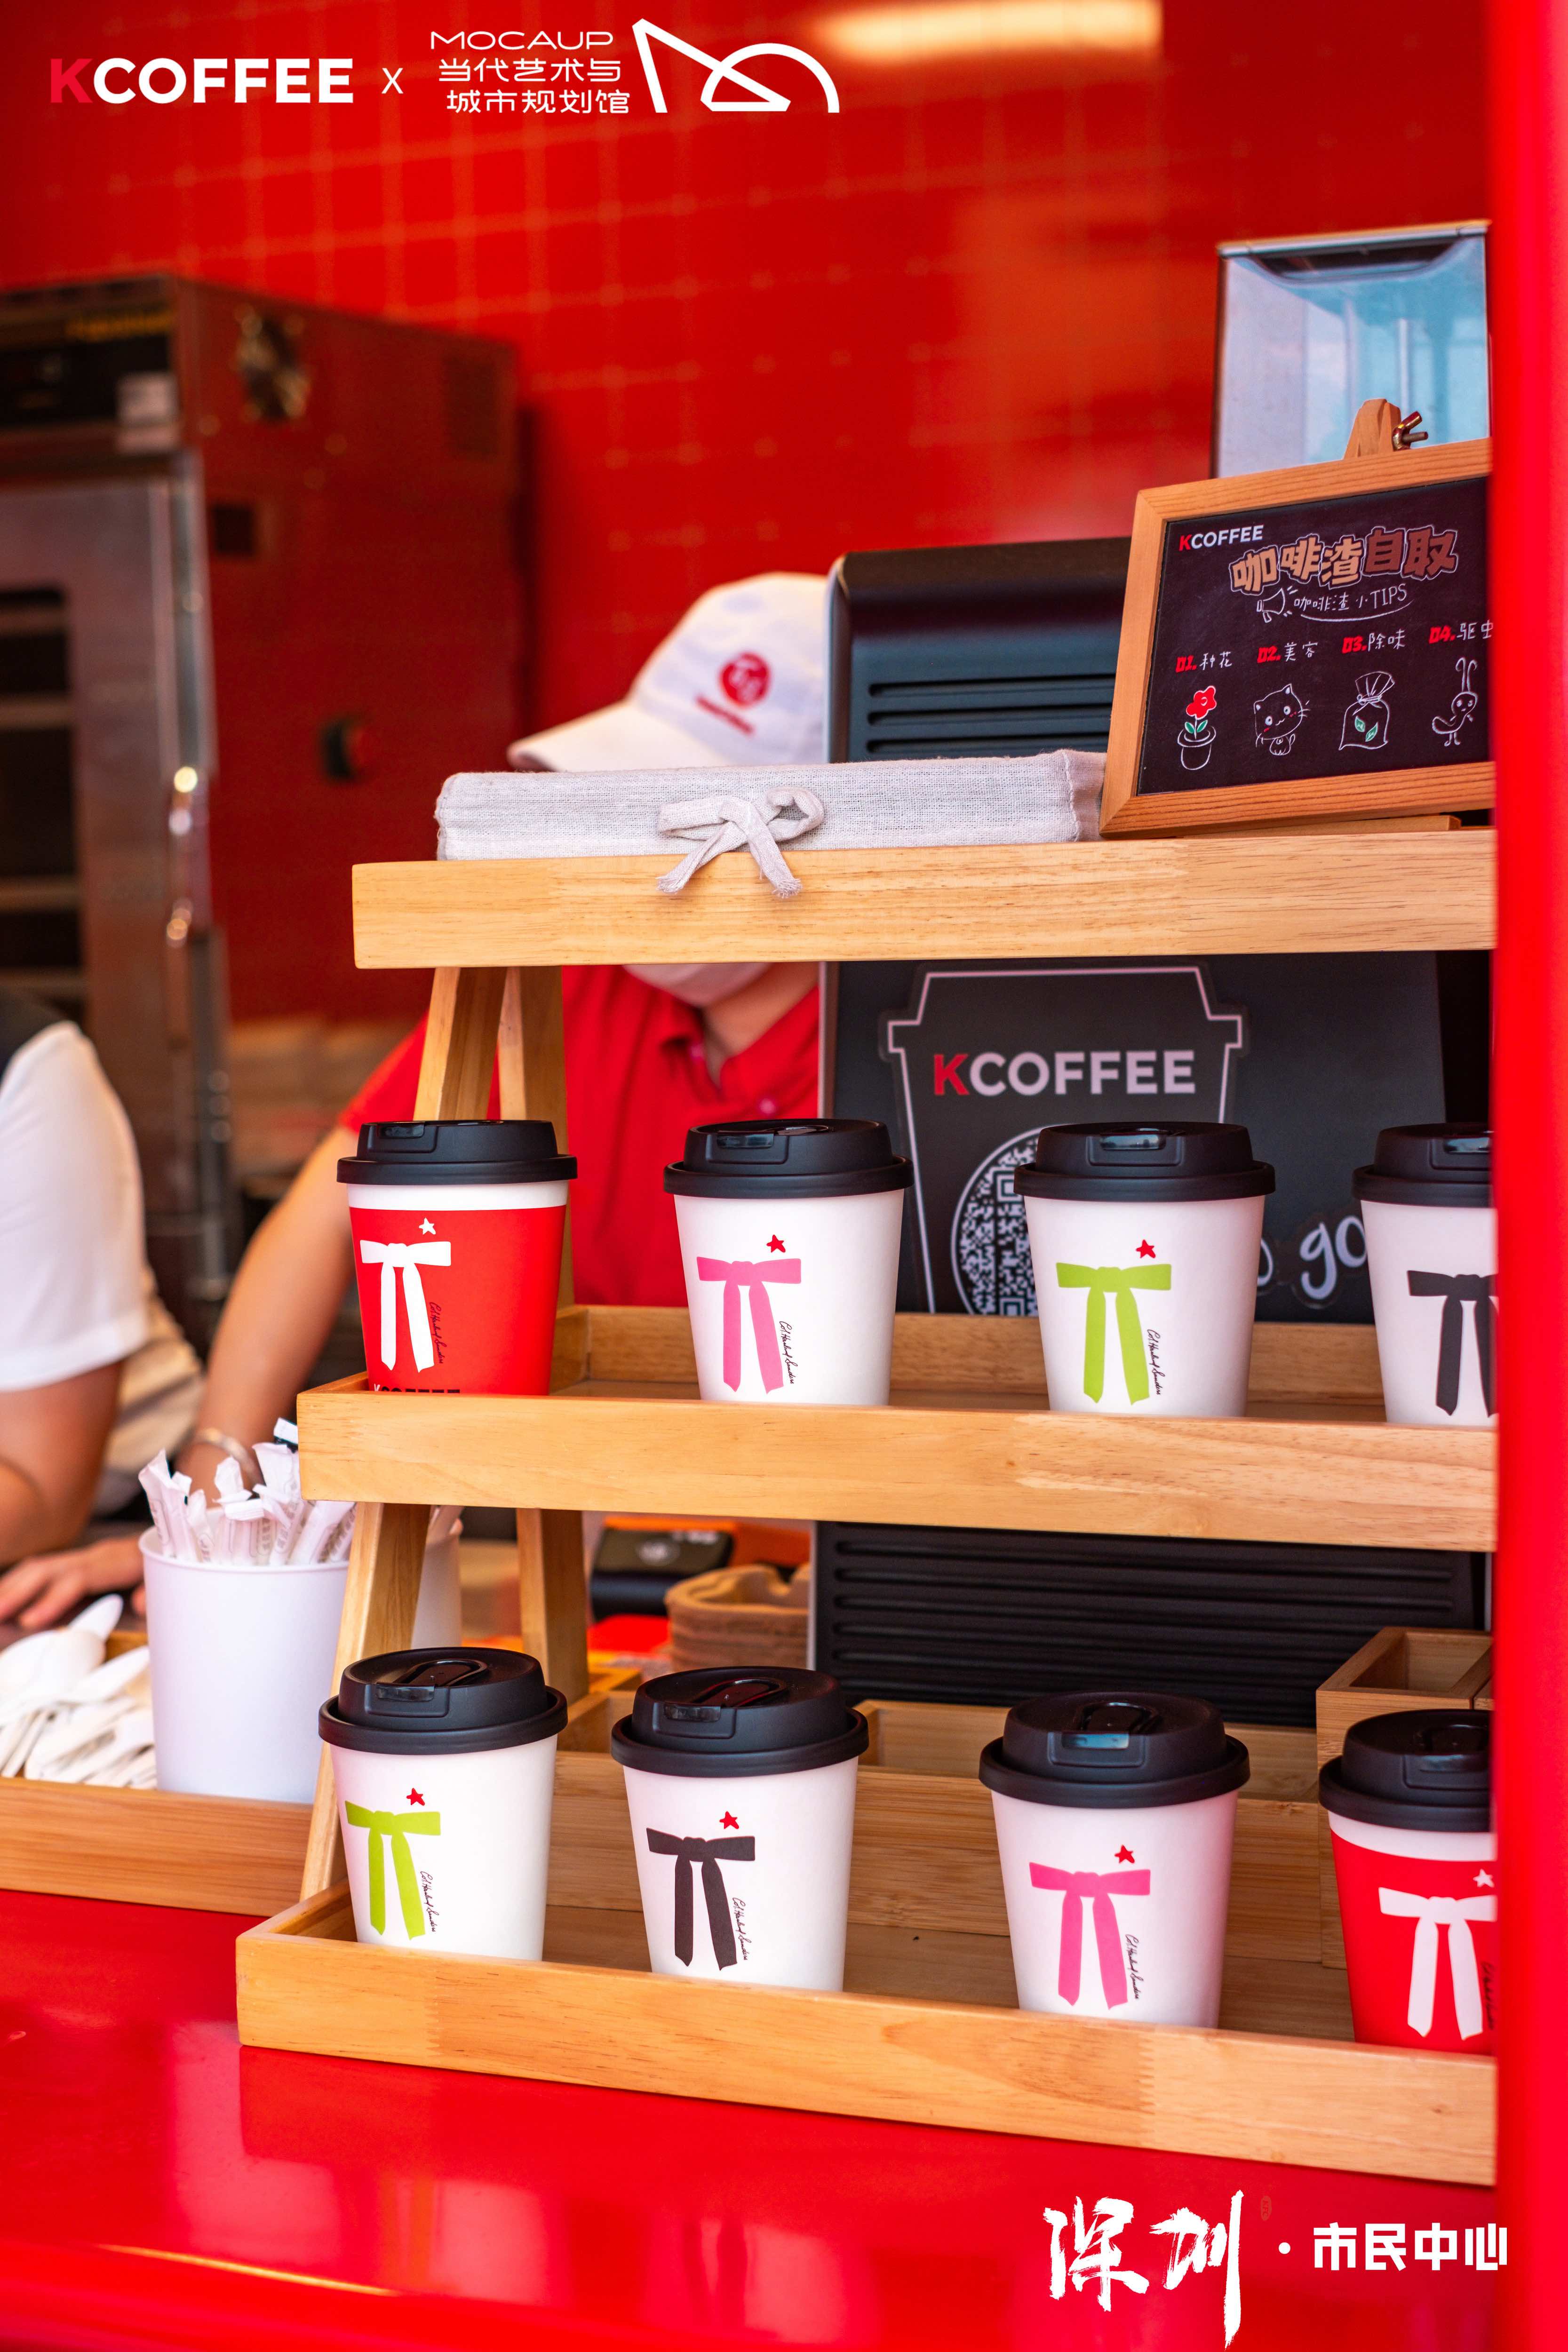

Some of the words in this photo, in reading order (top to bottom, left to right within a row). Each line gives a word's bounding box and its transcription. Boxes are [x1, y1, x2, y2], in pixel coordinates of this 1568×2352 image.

[1179, 525, 1264, 551] KCOFFEE
[1232, 528, 1457, 592] 咖啡渣自取
[934, 1050, 1195, 1096] KCOFFEE
